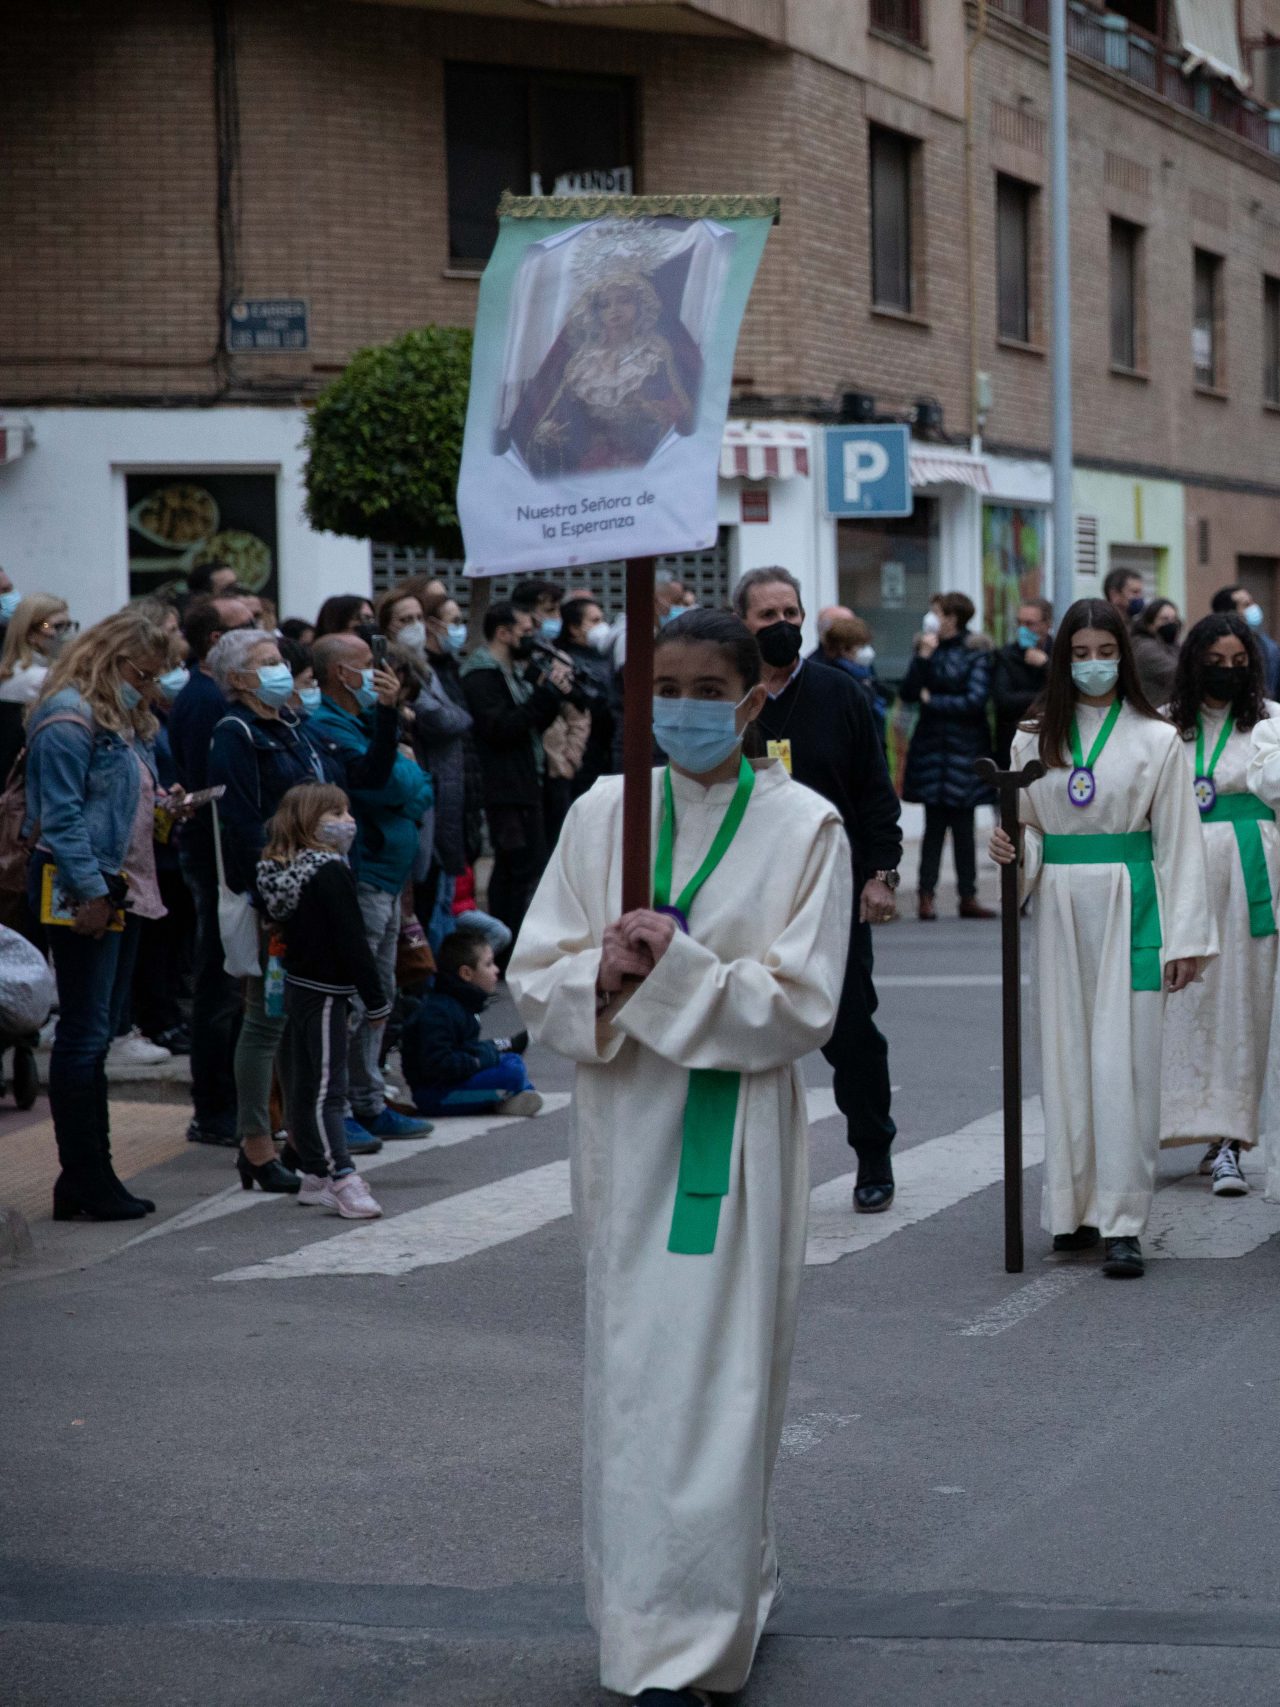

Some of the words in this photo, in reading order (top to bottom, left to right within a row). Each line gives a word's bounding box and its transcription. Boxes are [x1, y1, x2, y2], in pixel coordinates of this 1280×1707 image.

[566, 171, 626, 193] VENDE
[842, 439, 890, 503] P
[516, 503, 578, 521] Nuestra
[580, 496, 632, 513] Señora
[636, 491, 656, 506] de
[542, 523, 556, 539] la
[560, 515, 636, 538] Esperanza
